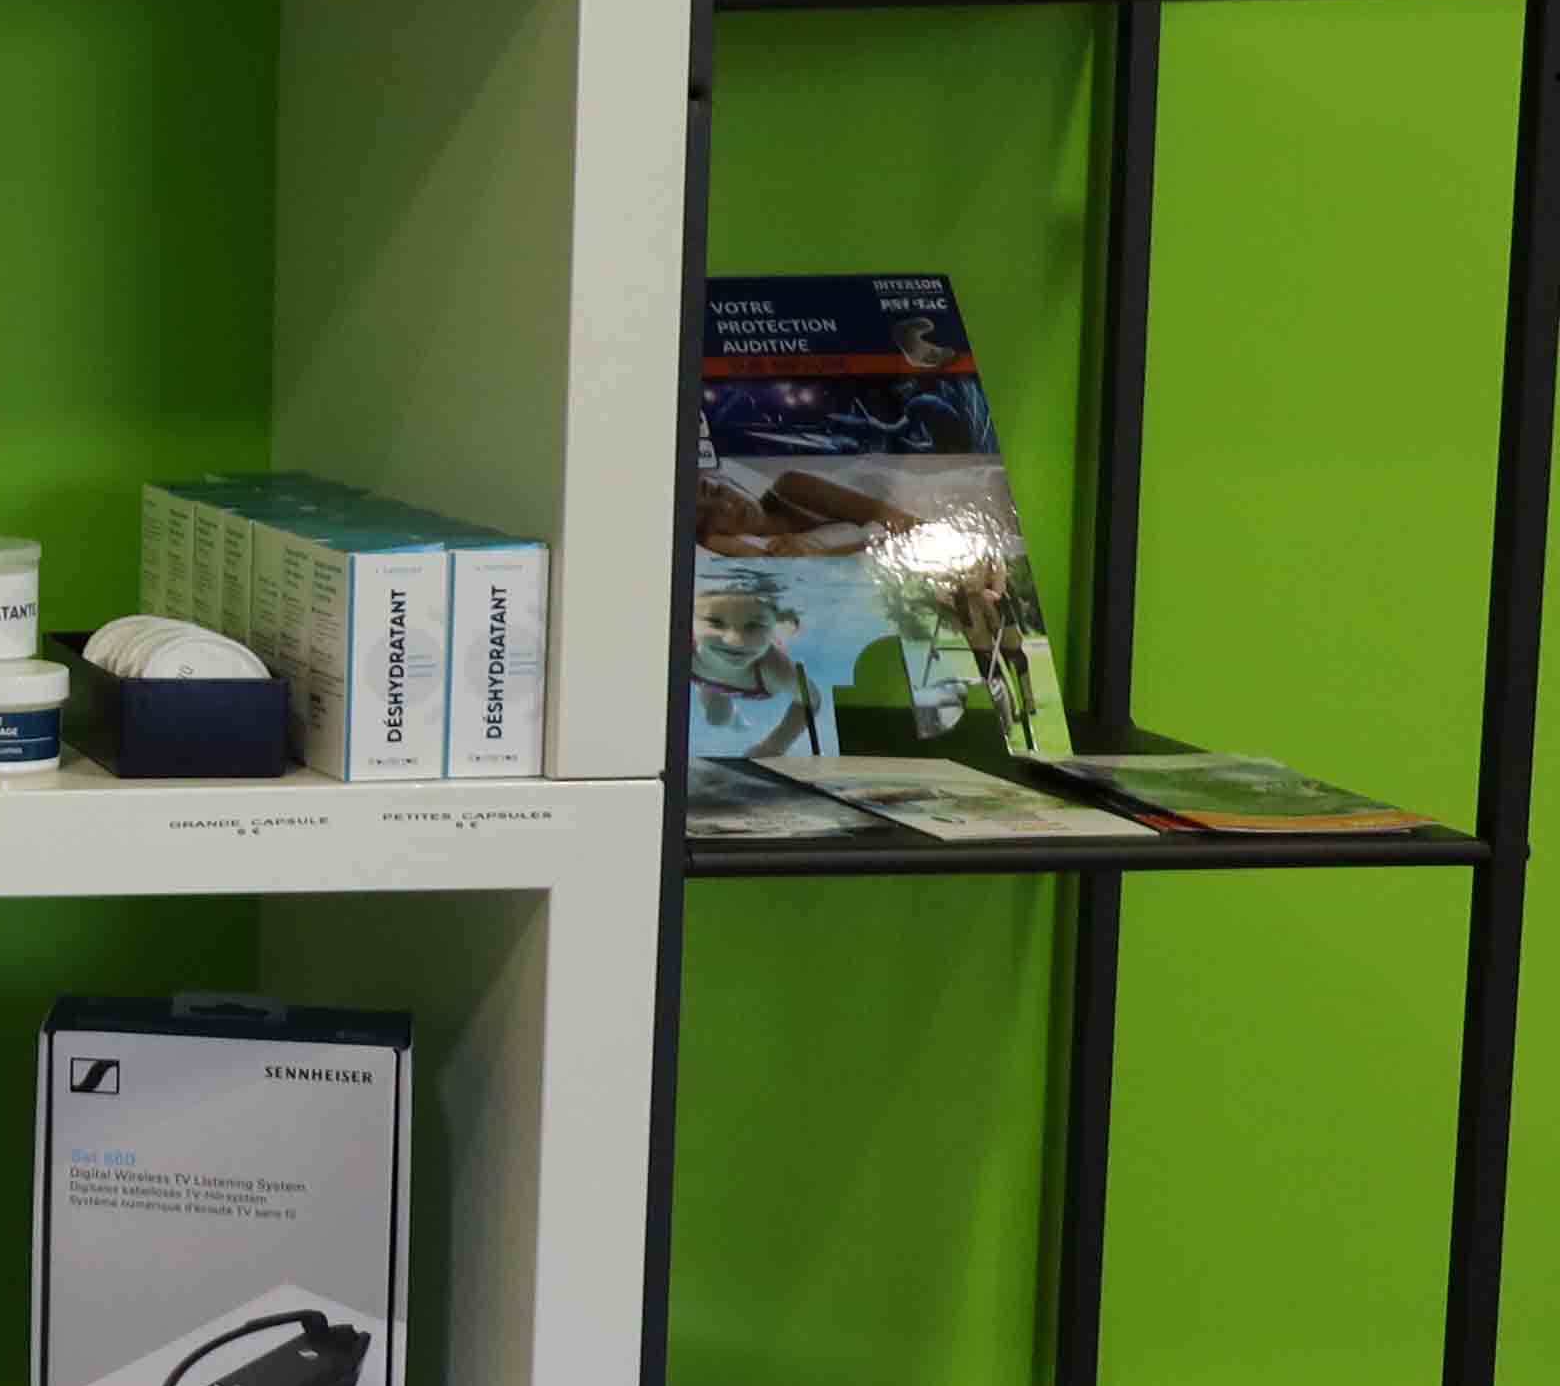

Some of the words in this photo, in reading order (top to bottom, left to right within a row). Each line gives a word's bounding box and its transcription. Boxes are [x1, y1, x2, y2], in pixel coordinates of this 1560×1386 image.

[711, 301, 774, 315] VOTRE
[717, 319, 838, 334] PROTECTION
[722, 338, 809, 353] AUDITIVE
[385, 588, 408, 744] DÉSHYDRATANT
[485, 585, 508, 741] DÉSHYDRATANT
[265, 1066, 373, 1085] SENNHEISER
[70, 1168, 111, 1182] Digital
[174, 1173, 191, 1186] TV
